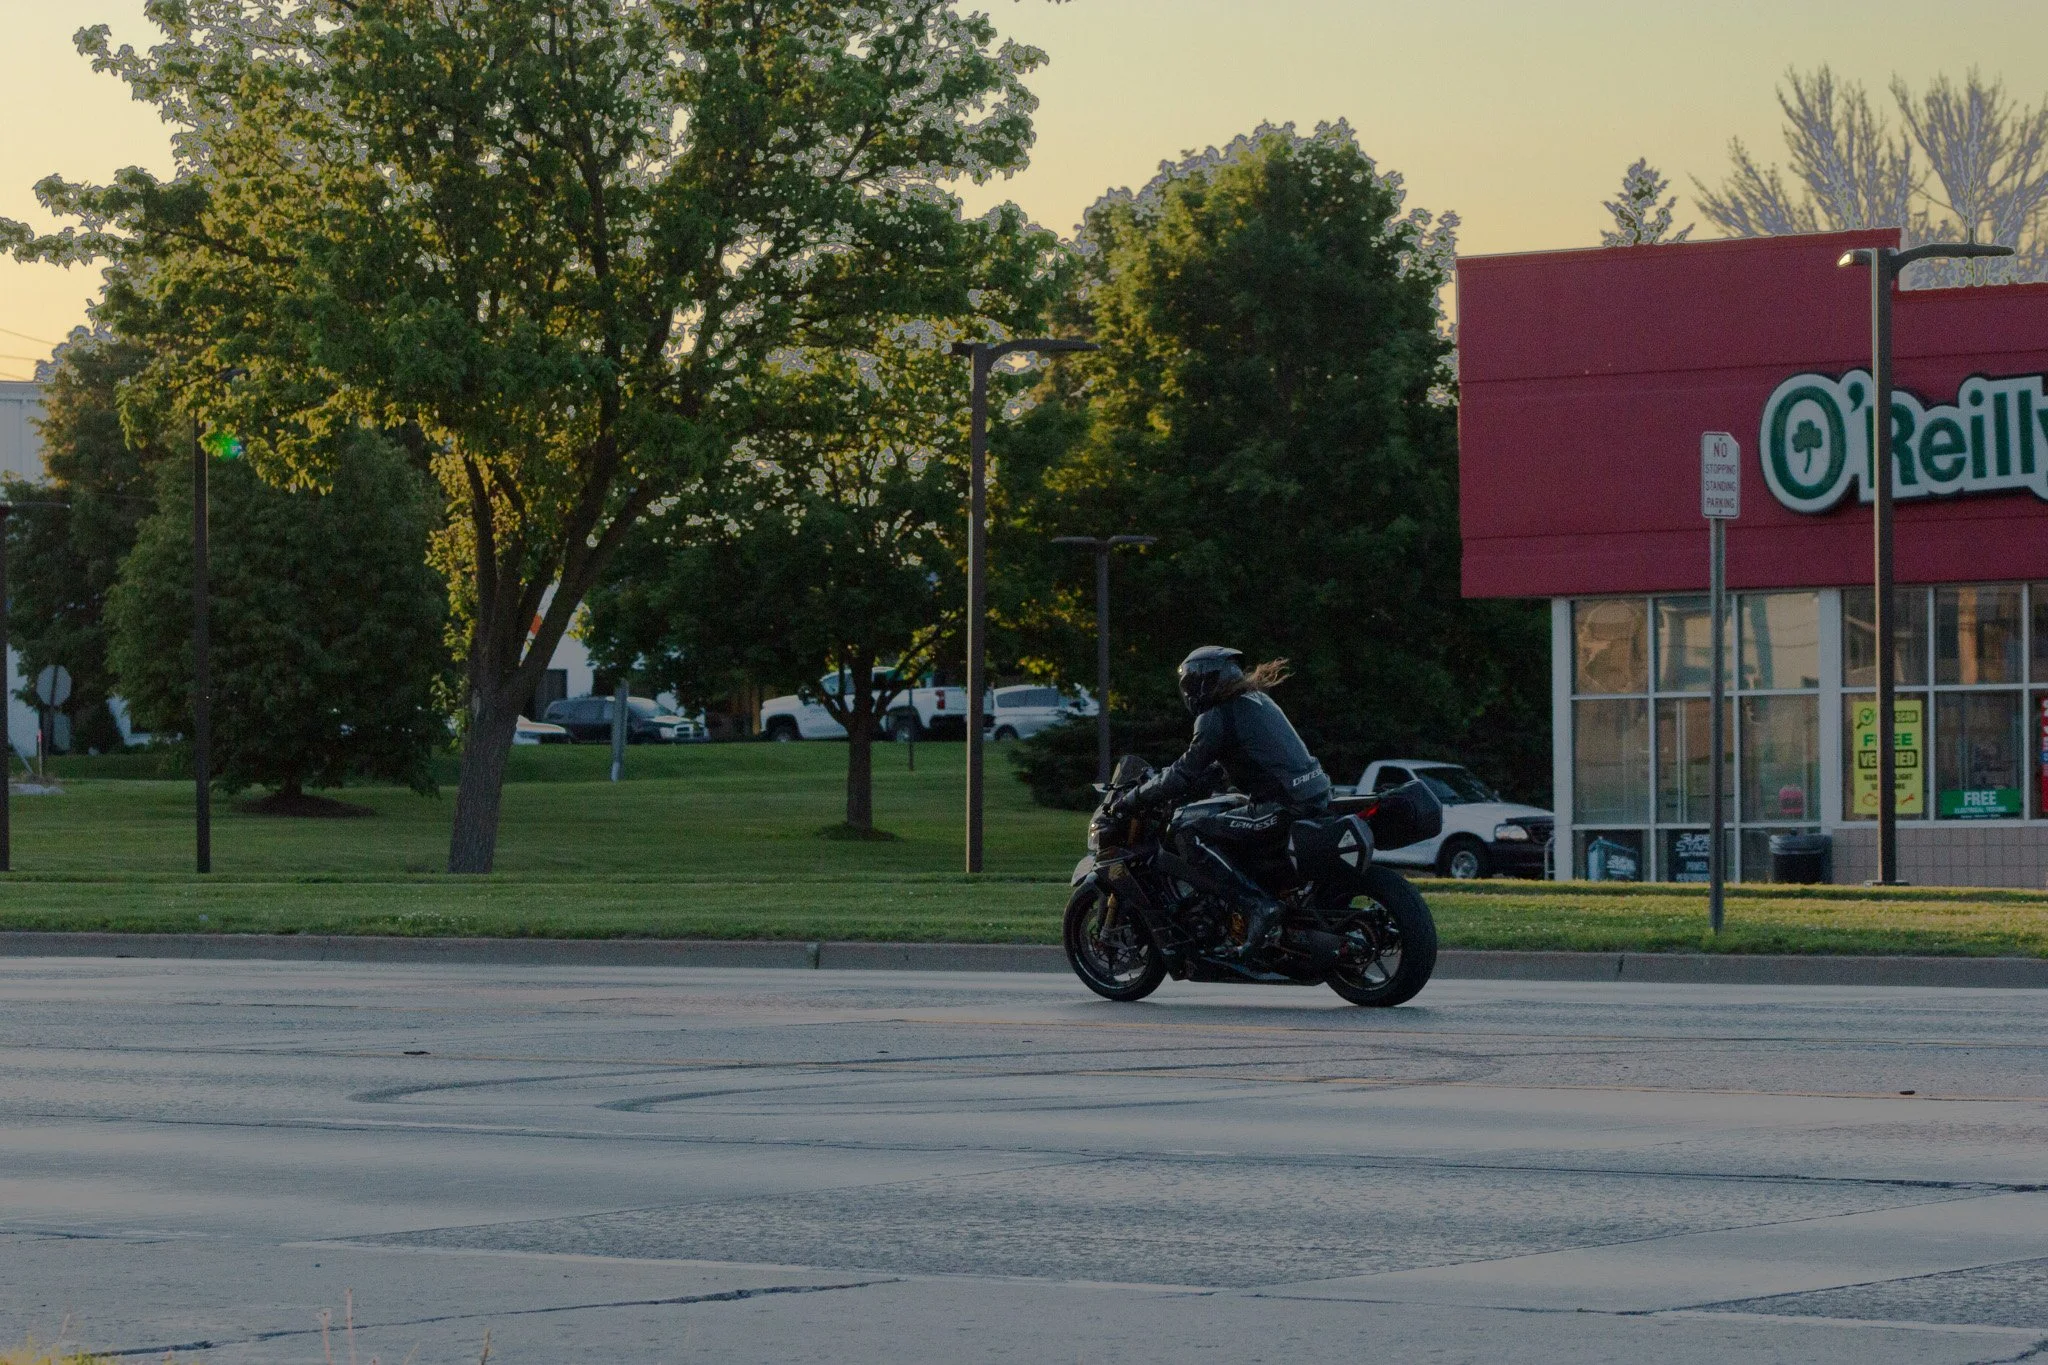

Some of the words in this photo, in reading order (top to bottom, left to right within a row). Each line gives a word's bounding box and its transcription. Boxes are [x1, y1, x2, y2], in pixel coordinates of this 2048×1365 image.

[1713, 443, 1728, 457] NO
[1705, 464, 1736, 475] STOPPING
[1705, 481, 1736, 492] STANDING
[1706, 498, 1735, 508] PARKING
[1964, 791, 1997, 806] FREE
